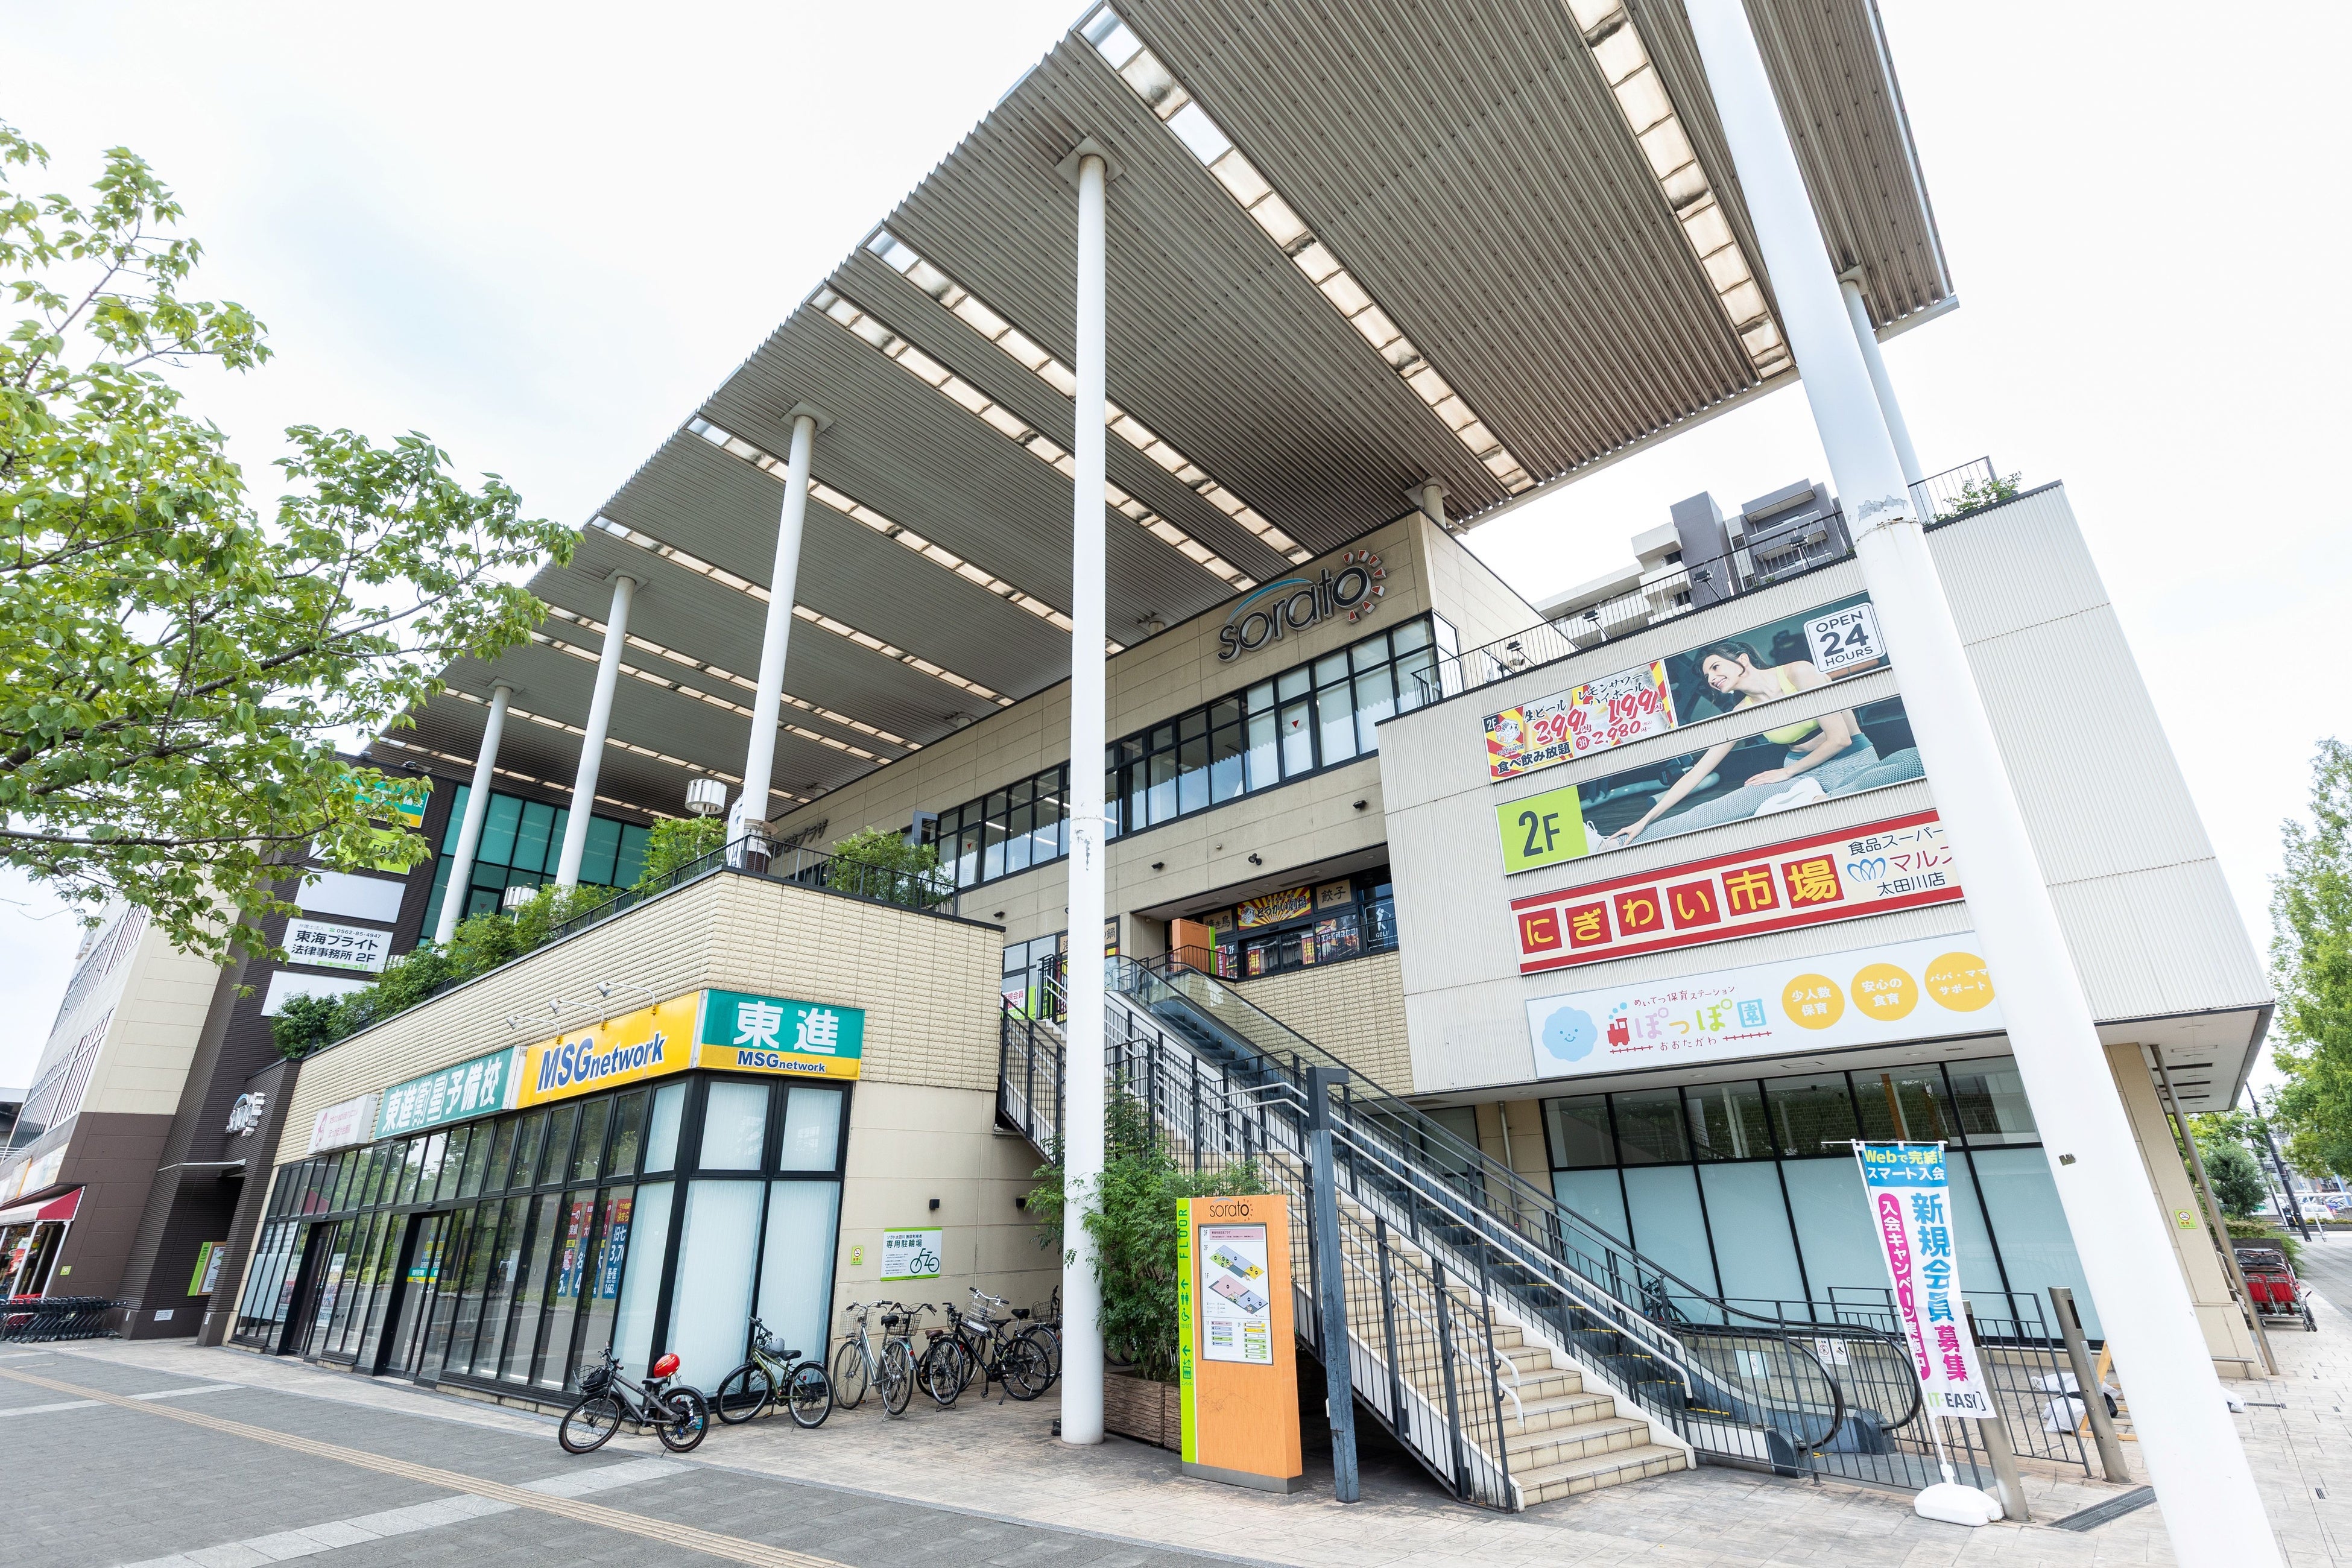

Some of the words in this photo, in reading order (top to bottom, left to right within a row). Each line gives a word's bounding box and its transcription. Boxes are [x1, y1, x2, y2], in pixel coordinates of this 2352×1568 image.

[1216, 566, 1372, 662] sorato
[1816, 610, 1863, 632] OPEN
[1819, 623, 1869, 657] 24
[1826, 646, 1873, 666] HOURS
[1578, 674, 1643, 700] レモンサワー
[1590, 682, 1645, 706] ハイボール
[1523, 700, 1567, 722] 生ビール
[1486, 718, 1496, 731] 2F
[1497, 741, 1571, 773] 食べ飲み放題
[1517, 809, 1561, 858] 2F
[1848, 827, 1944, 856] 食品スーパー
[1321, 886, 1346, 903] 餃子
[1877, 872, 1946, 897] 太田川店
[1257, 896, 1307, 918] とうかい劇場
[1526, 857, 1839, 947] にぎわい市場
[295, 931, 378, 950] 東海ブライト
[337, 928, 381, 939] 0562-85-4947
[1104, 928, 1115, 940] 鍋
[291, 944, 353, 961] 法律事務所
[356, 953, 376, 963] 2F
[1228, 945, 1234, 955] 2F
[1861, 976, 1903, 993] 安心の
[1929, 967, 1988, 982] パパ・ママ
[1634, 986, 1735, 1007] めいてつ保育ステーション
[1791, 985, 1832, 1003] 少人数
[1939, 981, 1987, 996] サポート
[1801, 1002, 1828, 1017] 保育
[1873, 992, 1900, 1008] 食育
[733, 1001, 839, 1055] 東進
[1634, 997, 1767, 1040] ぽっぽ園
[1660, 1036, 1717, 1052] おおたがわ
[537, 1032, 666, 1092] MSGnetwork
[737, 1050, 826, 1073] MSGnetwork
[381, 1057, 503, 1133] 東進衛星予備校
[1864, 1149, 1943, 1165] Webで完結!
[1867, 1166, 1946, 1181] スマート入会
[1209, 1200, 1250, 1218] sorato
[887, 1239, 922, 1248] 専用駐輪場
[1178, 1209, 1189, 1259] FLOOR
[1911, 1192, 1968, 1382] 新規会員募集
